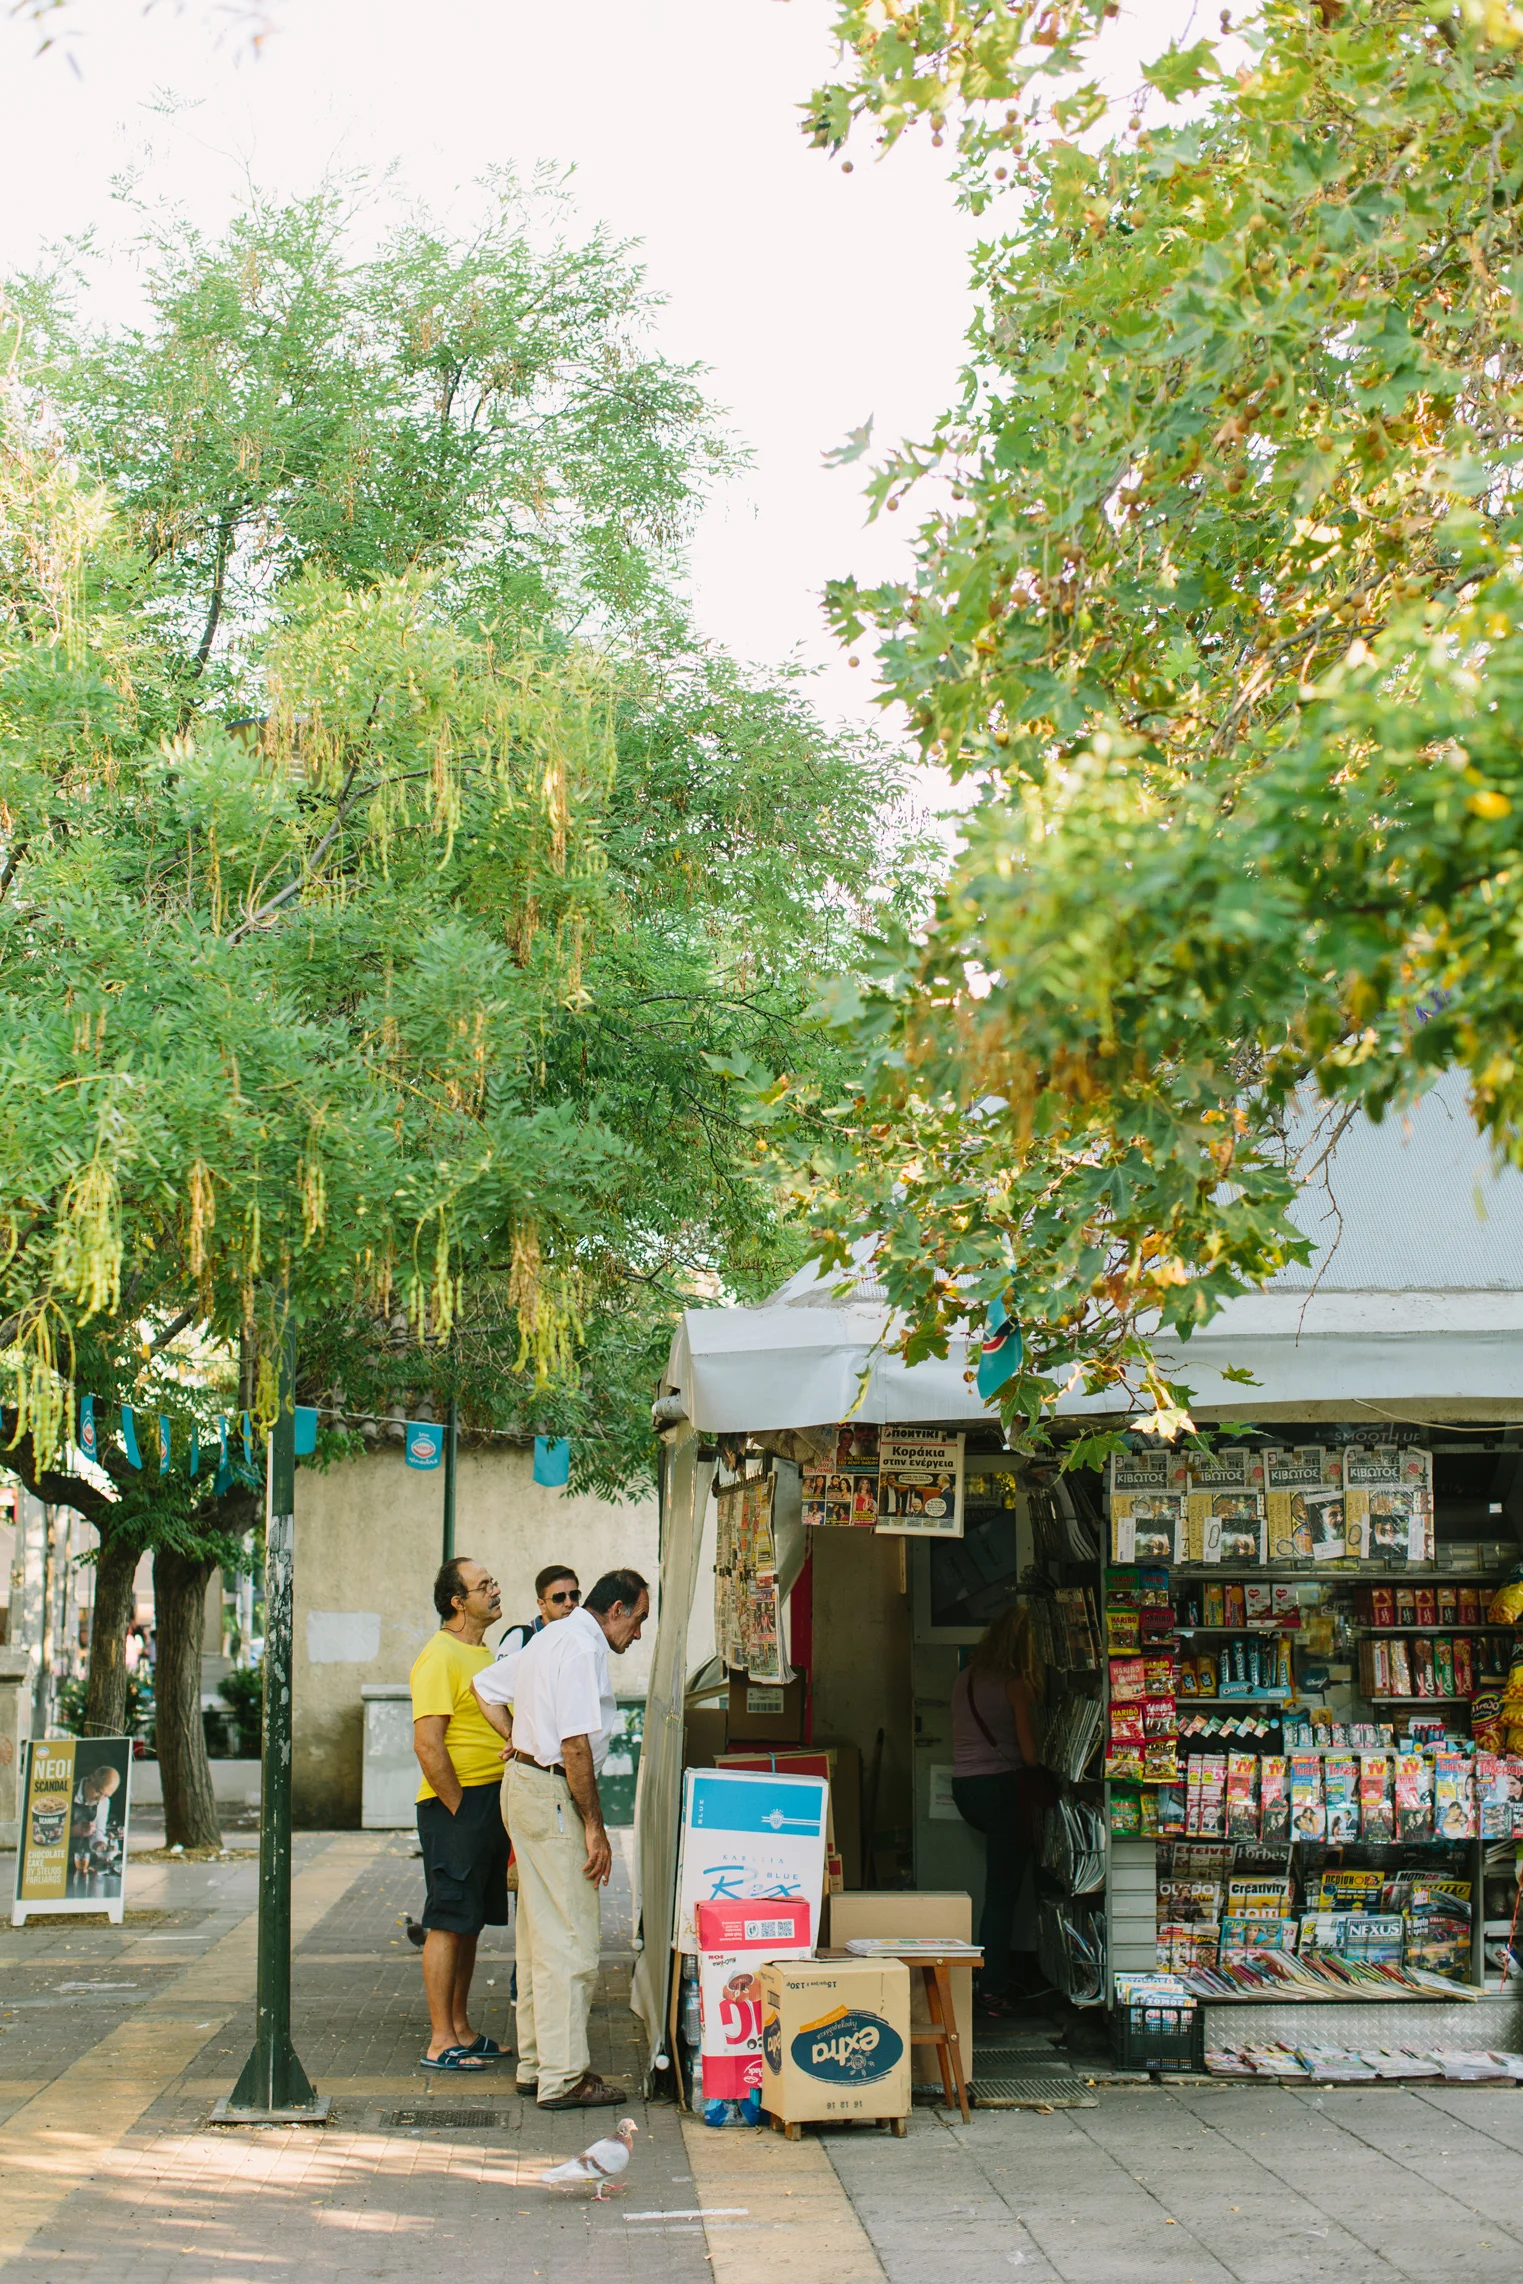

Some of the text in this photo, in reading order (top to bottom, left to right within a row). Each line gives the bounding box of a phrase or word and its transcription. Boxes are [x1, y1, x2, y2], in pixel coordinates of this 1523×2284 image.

[1334, 1431, 1400, 1443] SMOOTH
[892, 1446, 945, 1459] Κοράκια
[883, 1457, 954, 1469] στην ενέργεια
[1116, 1473, 1166, 1484] ΚΙΒΩΤΟΣ
[1199, 1470, 1243, 1482] ΙΒΩΤΟΣ
[1271, 1468, 1319, 1480] ΚΙΒΩΤΟΣ
[1350, 1467, 1398, 1479] ΚΙΒΩΤΟΣ
[1110, 1616, 1137, 1624] HARIBO
[1144, 1614, 1171, 1622] HARIBO
[1113, 1665, 1141, 1675] HARIBO
[1144, 1660, 1170, 1669] HARIBO
[1443, 1664, 1453, 1691] Cookies
[1111, 1708, 1139, 1718] HARIBO
[1111, 1743, 1140, 1754] HARIBO
[34, 1780, 69, 1793] SCANDAL
[697, 1799, 705, 1825] BLUE
[27, 1849, 65, 1859] CHOCOLATE
[1237, 1845, 1288, 1861] Forbes
[27, 1858, 45, 1868] CAKE
[26, 1866, 62, 1877] BY STELIOS
[766, 1872, 799, 1880] BLUE
[25, 1875, 61, 1885] PARLIAROS
[703, 1865, 801, 1899] Rex
[1231, 1883, 1287, 1896] Creativity
[1349, 1924, 1401, 1937] NEXUS
[811, 2026, 881, 2067] extra
